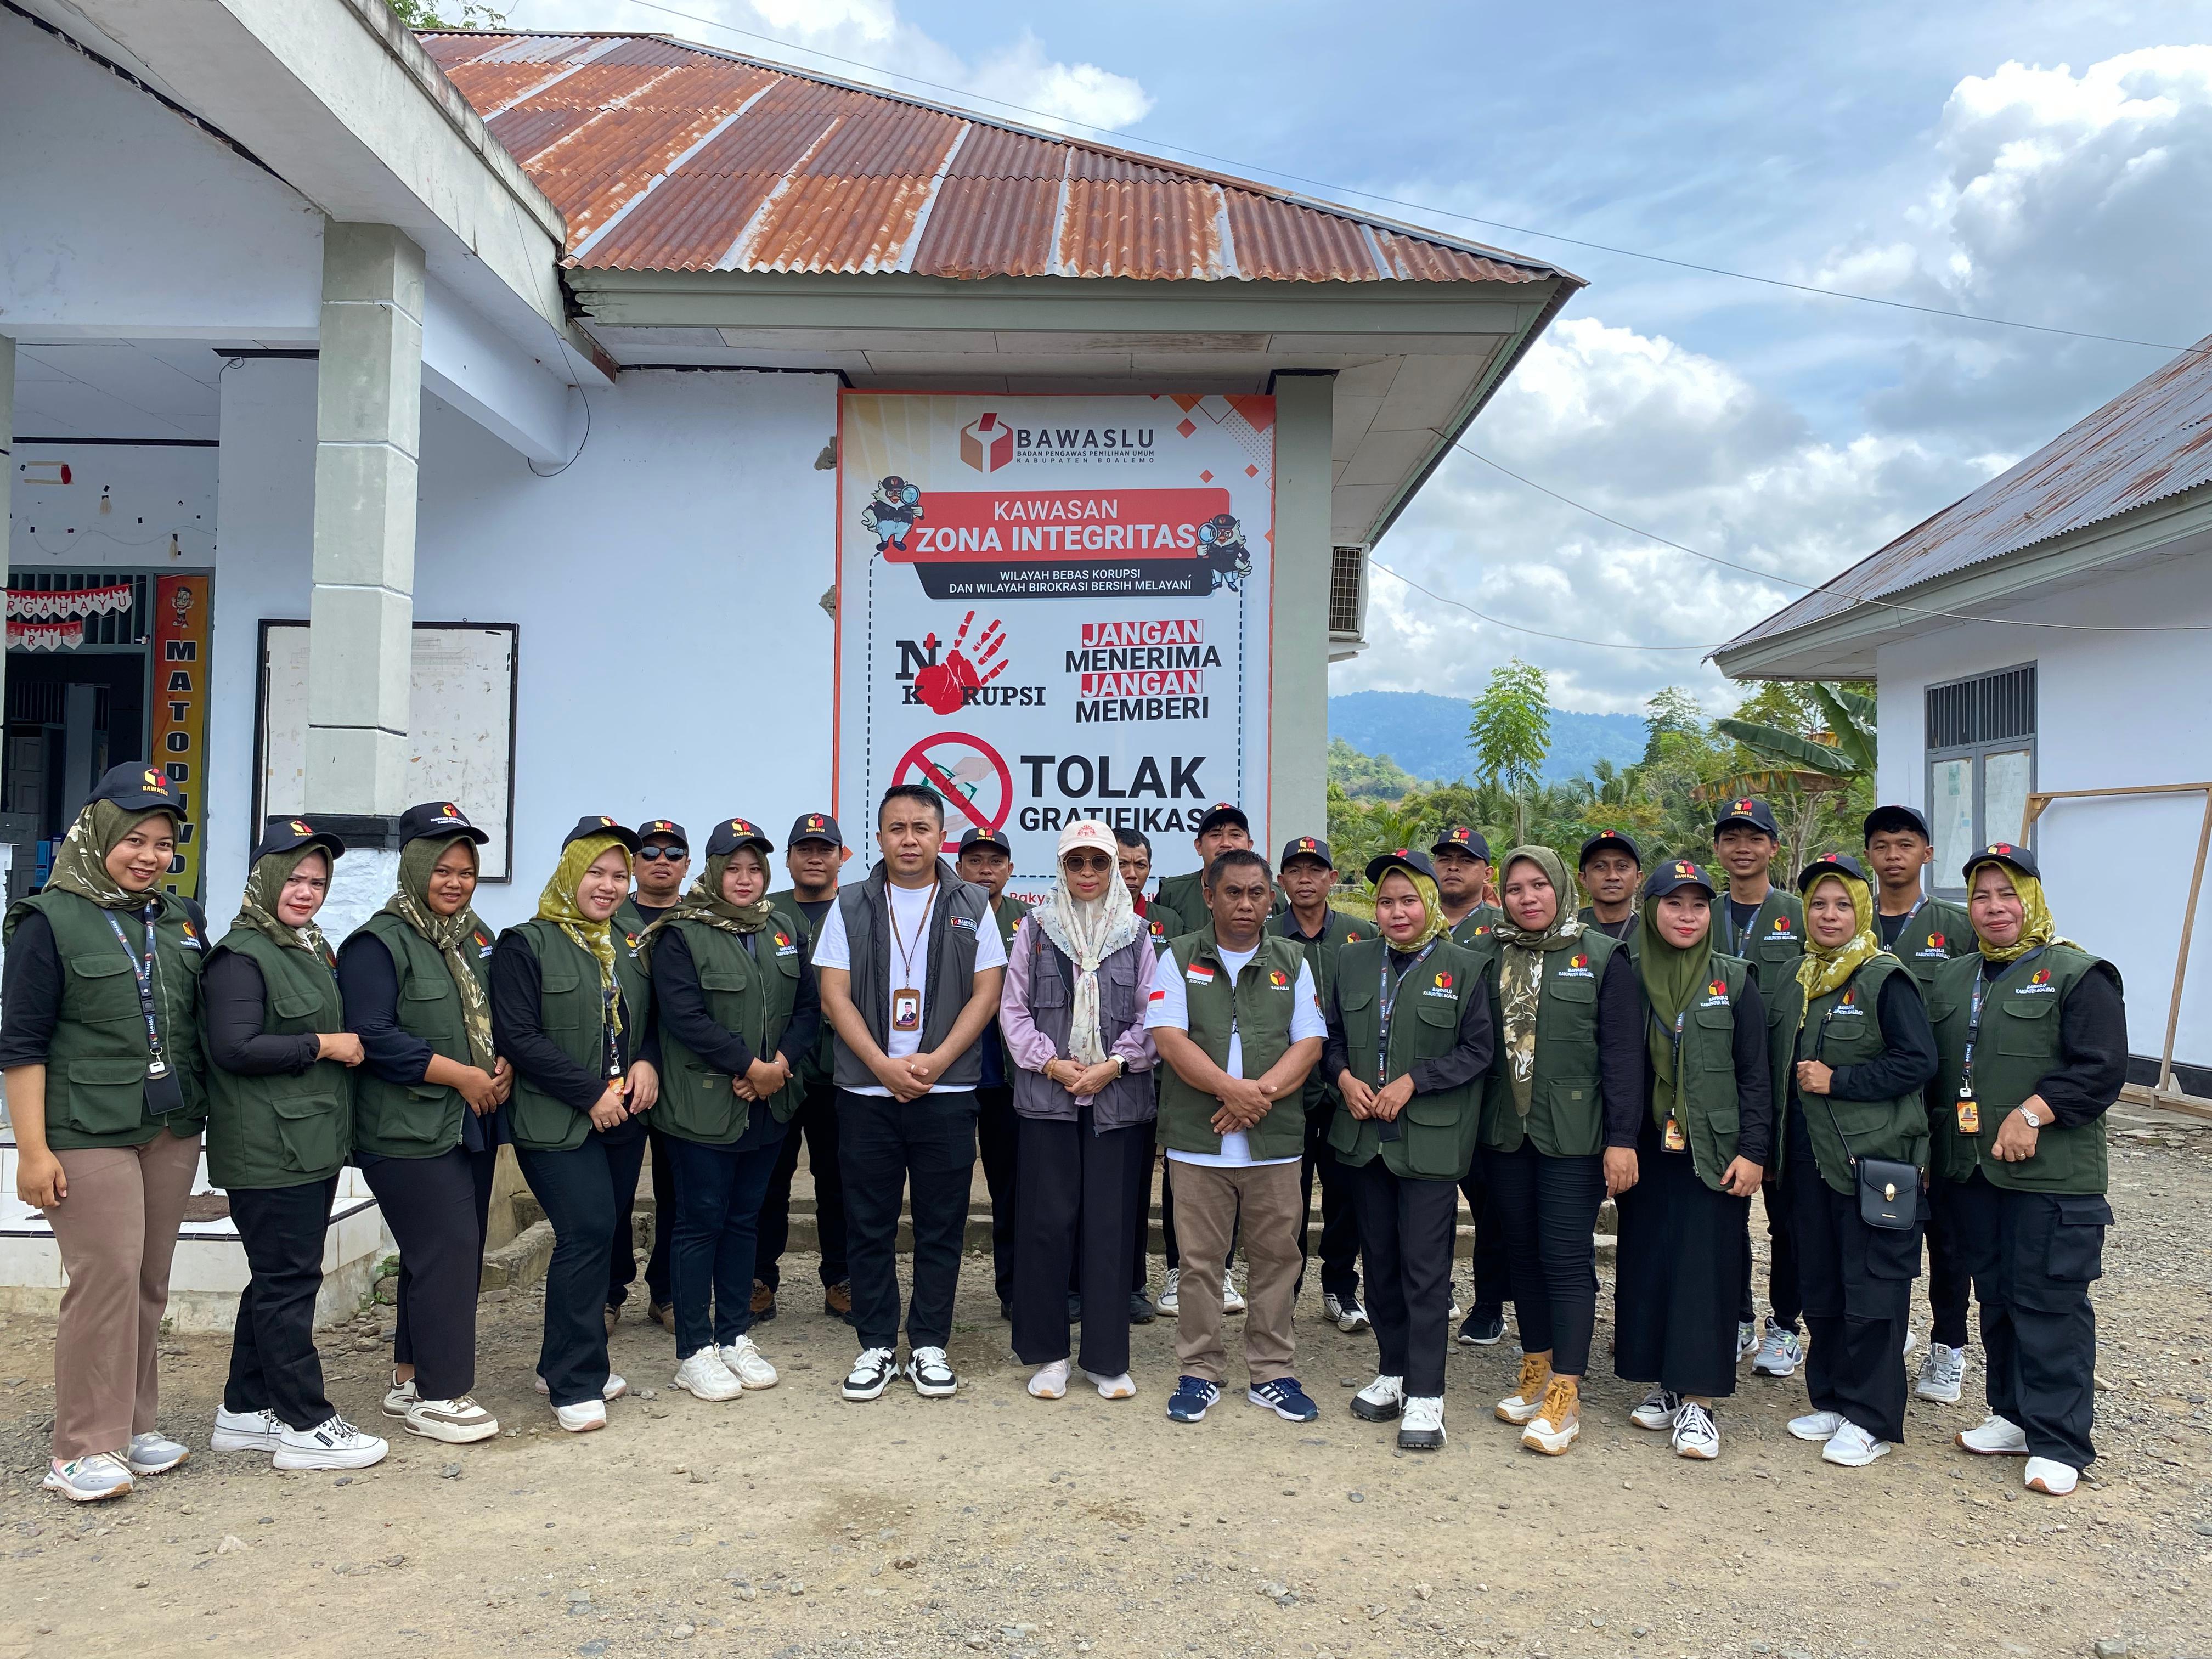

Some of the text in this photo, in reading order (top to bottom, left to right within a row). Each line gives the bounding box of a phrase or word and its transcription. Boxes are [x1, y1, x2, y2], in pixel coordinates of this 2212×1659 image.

[1017, 428, 1154, 448] BAWASLU
[994, 499, 1118, 521] KAWASAN
[916, 523, 1196, 552] ZONA INTEGRITAS
[950, 583, 973, 593] DAN
[976, 583, 1026, 593] WILAYAH
[1029, 582, 1088, 592] BIROKRASI
[1091, 581, 1131, 591] BERSIH
[1000, 569, 1141, 581] WILAYAH BEBAS KORUPSI
[1082, 620, 1204, 647] JANGAN
[1065, 645, 1222, 673] MENERIMA
[1082, 670, 1203, 697] JANGAN
[1076, 696, 1209, 723] MEMBERI
[1020, 755, 1206, 799] TOLAK
[142, 785, 168, 797] BAWASLU
